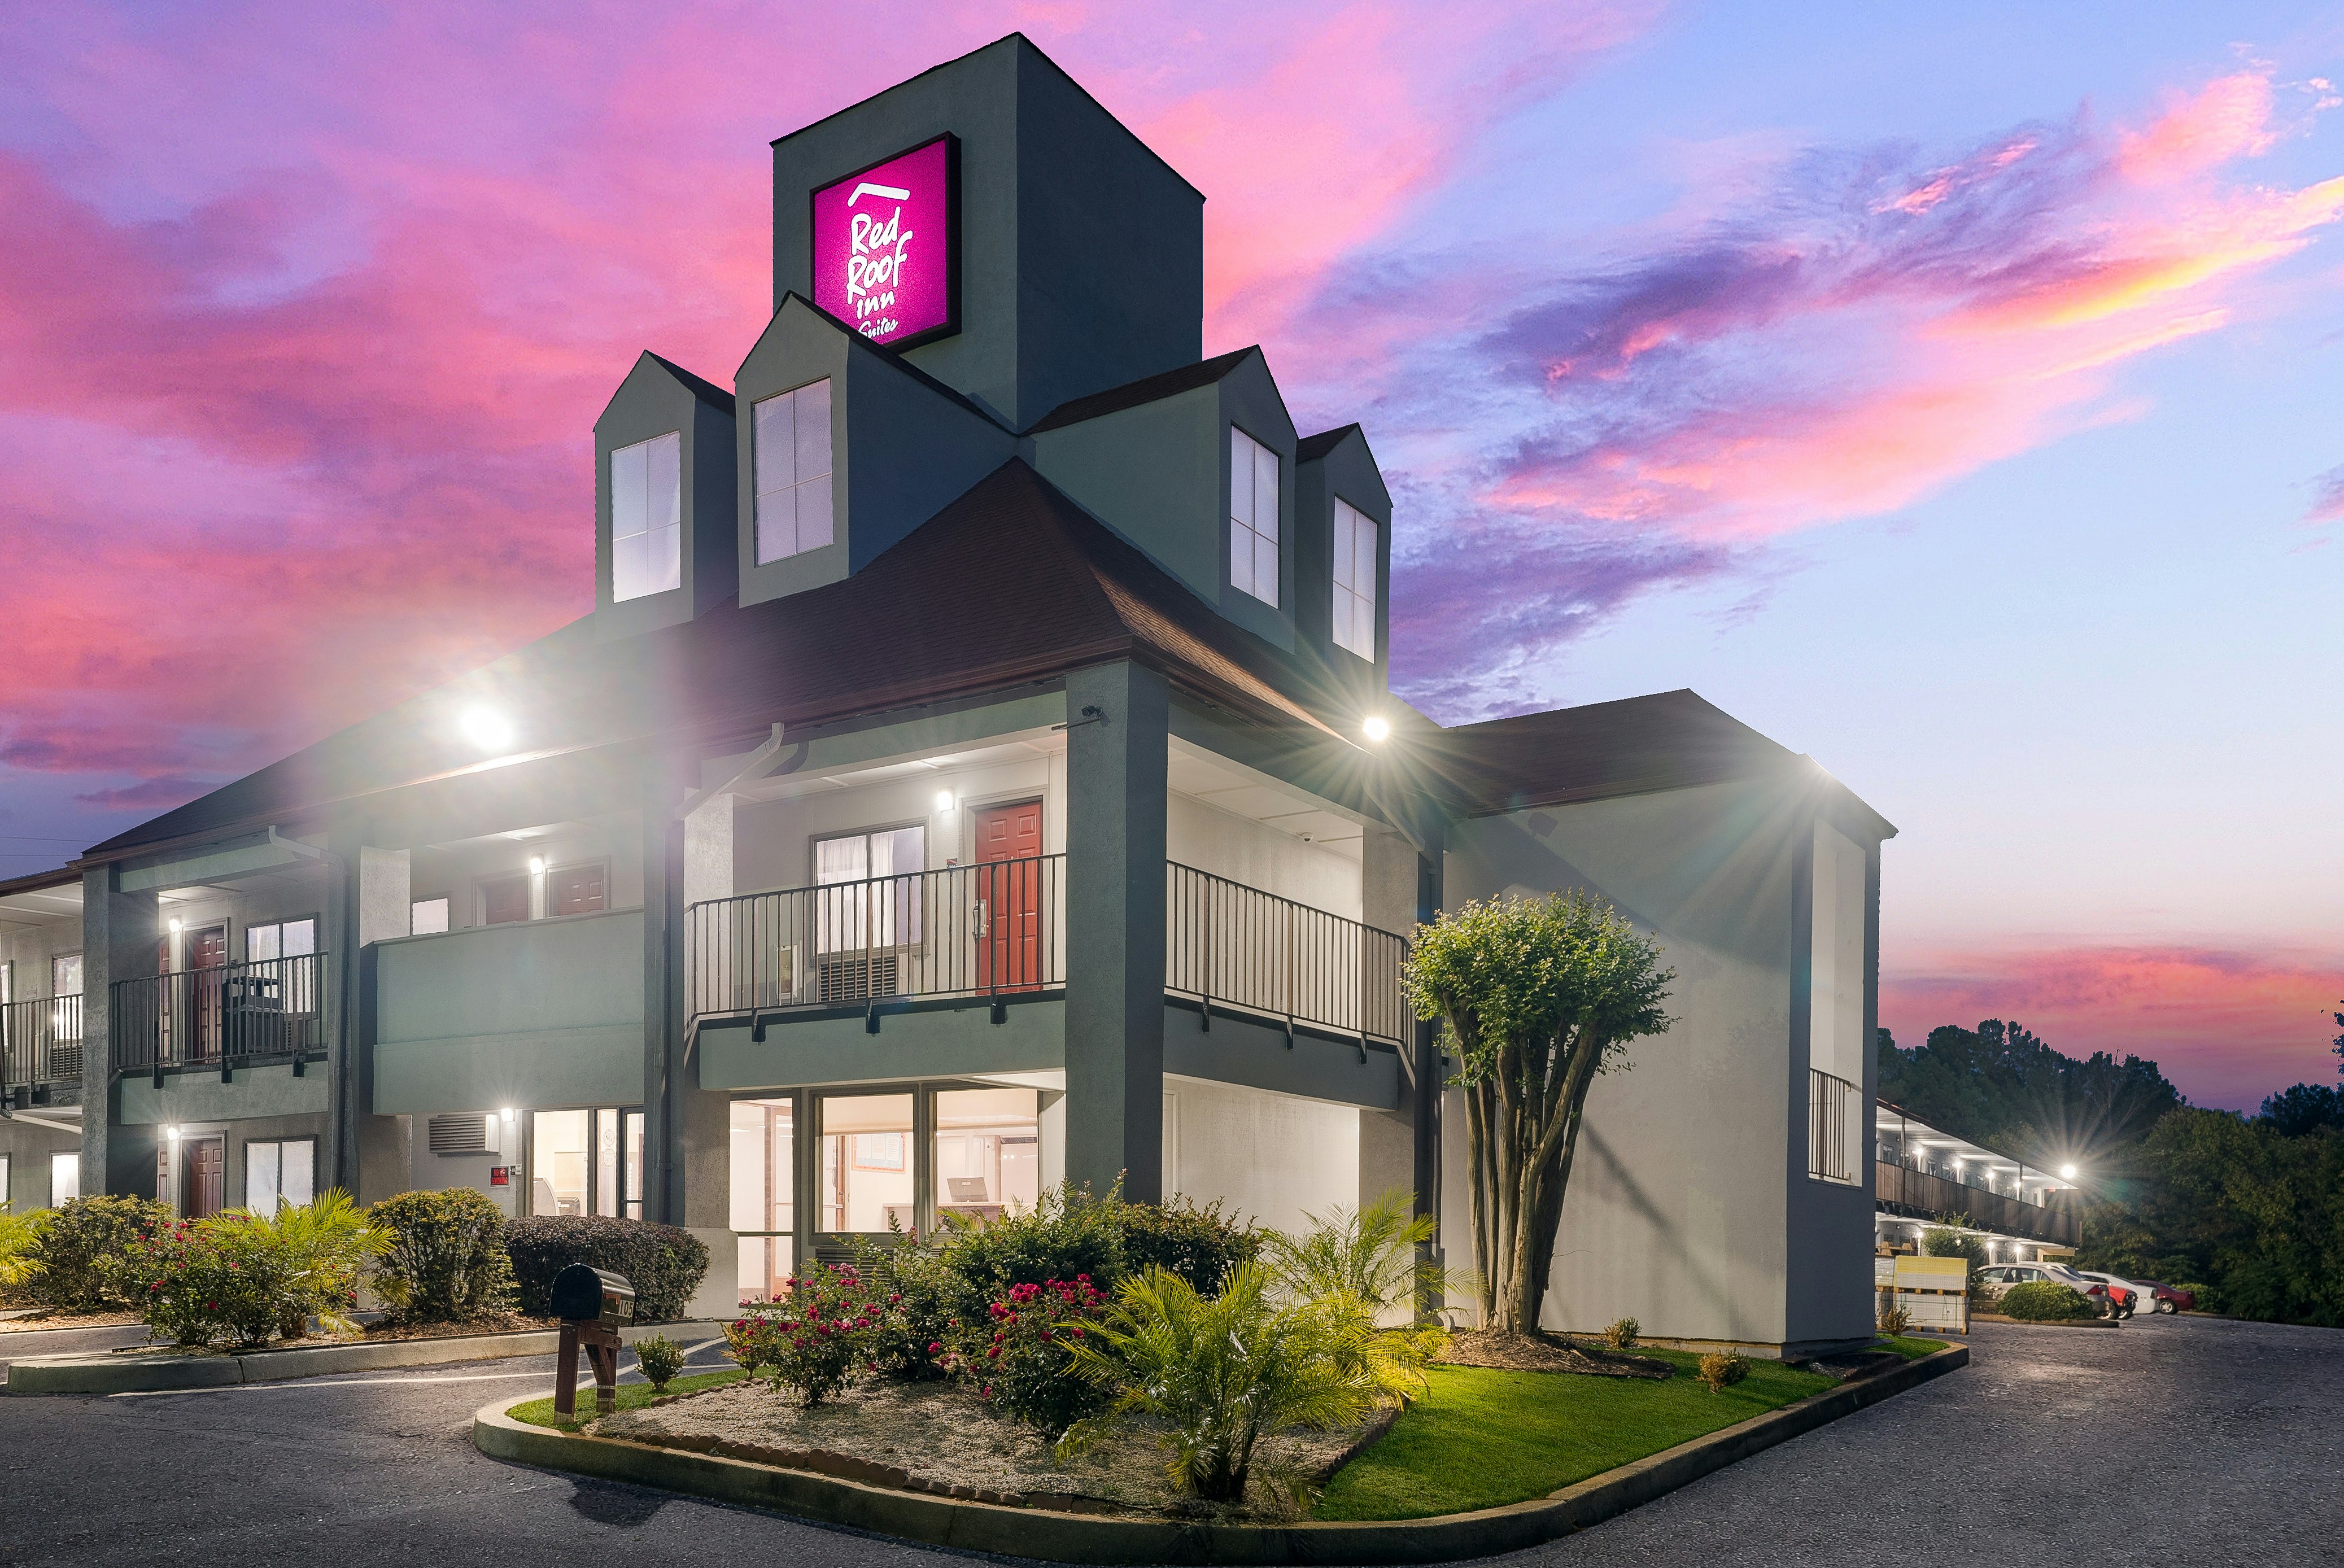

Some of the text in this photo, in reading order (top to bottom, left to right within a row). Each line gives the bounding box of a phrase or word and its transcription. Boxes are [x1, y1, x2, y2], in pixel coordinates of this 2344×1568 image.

[851, 206, 901, 256] Red
[846, 230, 913, 305] Roof
[858, 316, 898, 339] Suites
[620, 1300, 633, 1316] 105
